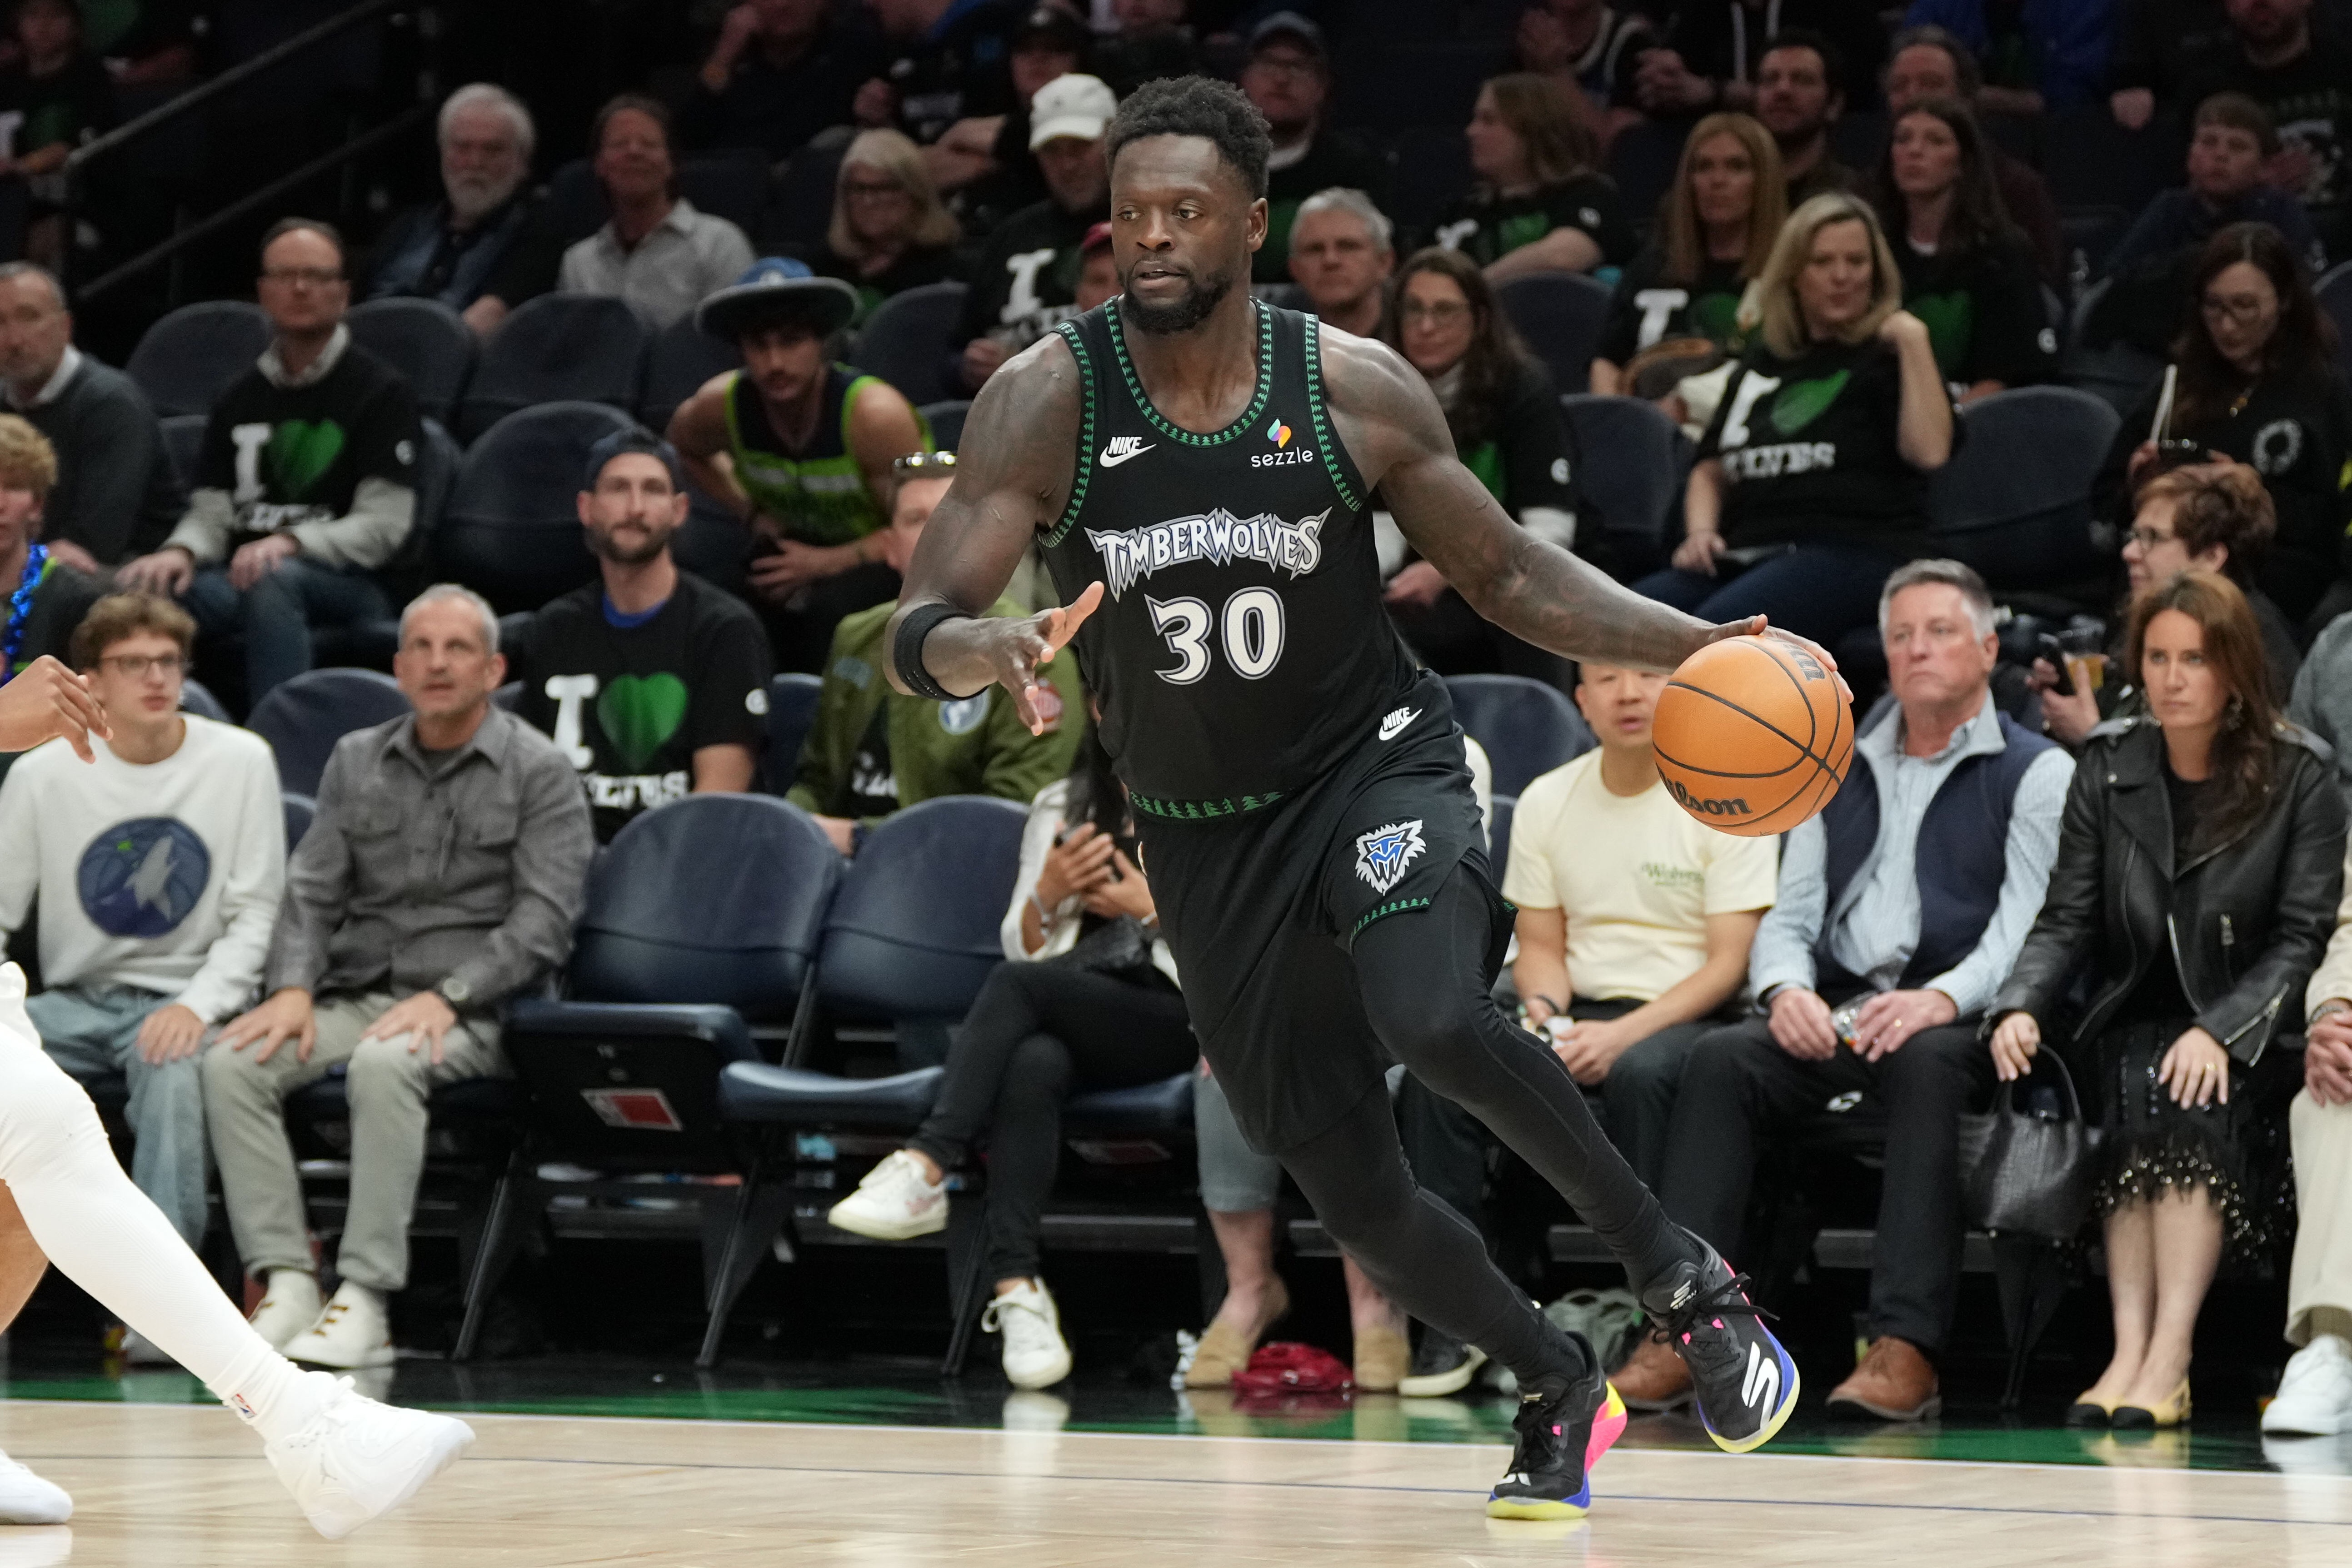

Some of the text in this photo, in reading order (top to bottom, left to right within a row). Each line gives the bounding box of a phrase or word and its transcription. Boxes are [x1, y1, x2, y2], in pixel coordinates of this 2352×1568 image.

[1108, 437, 1142, 454] NIKE
[1251, 446, 1313, 468] sezzle
[1084, 506, 1333, 602] TIMBERWOLVES
[1144, 586, 1286, 685] 30
[1382, 707, 1410, 732] NIKE
